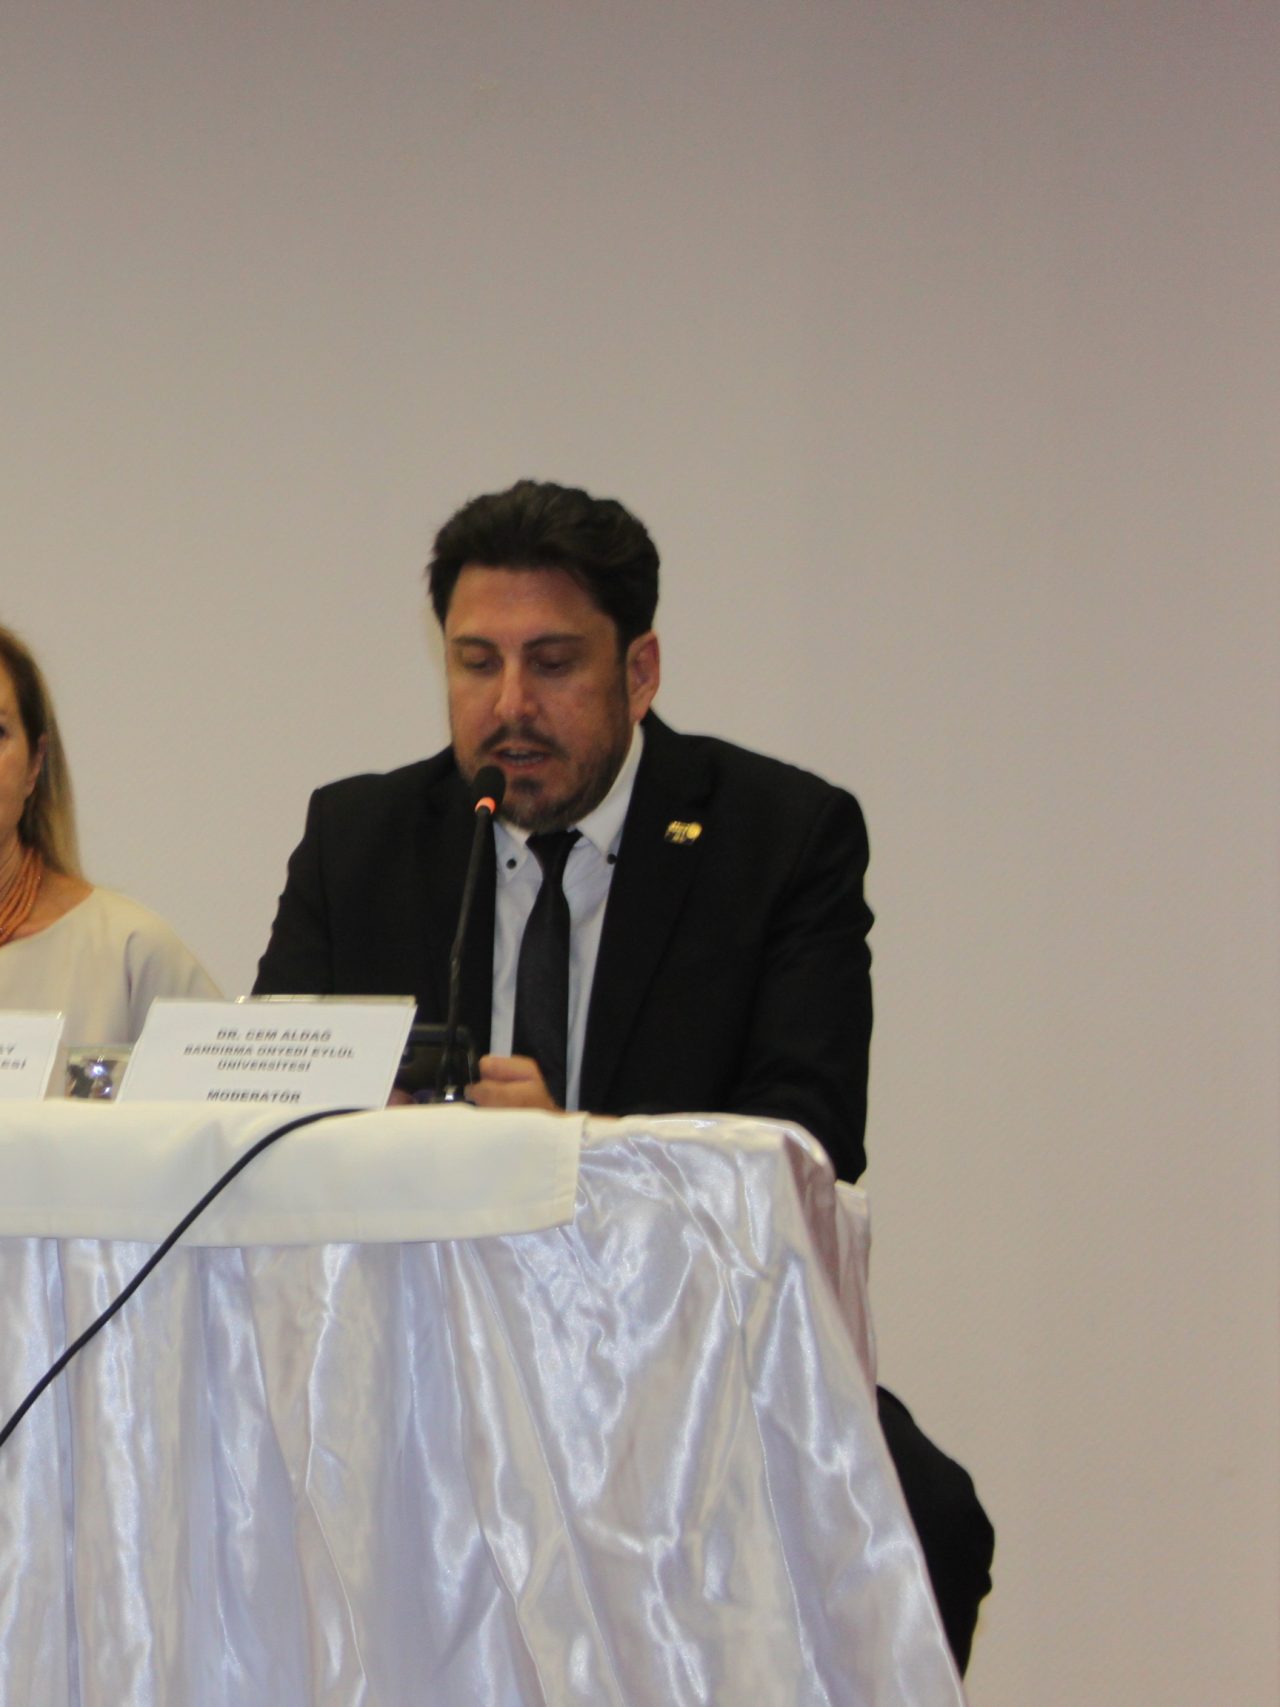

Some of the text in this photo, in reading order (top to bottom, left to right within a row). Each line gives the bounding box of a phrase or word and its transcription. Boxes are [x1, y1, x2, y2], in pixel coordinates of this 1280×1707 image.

[216, 1029, 240, 1041] DR.
[245, 1029, 278, 1041] CEM
[206, 1088, 301, 1103] MODERATÖR
